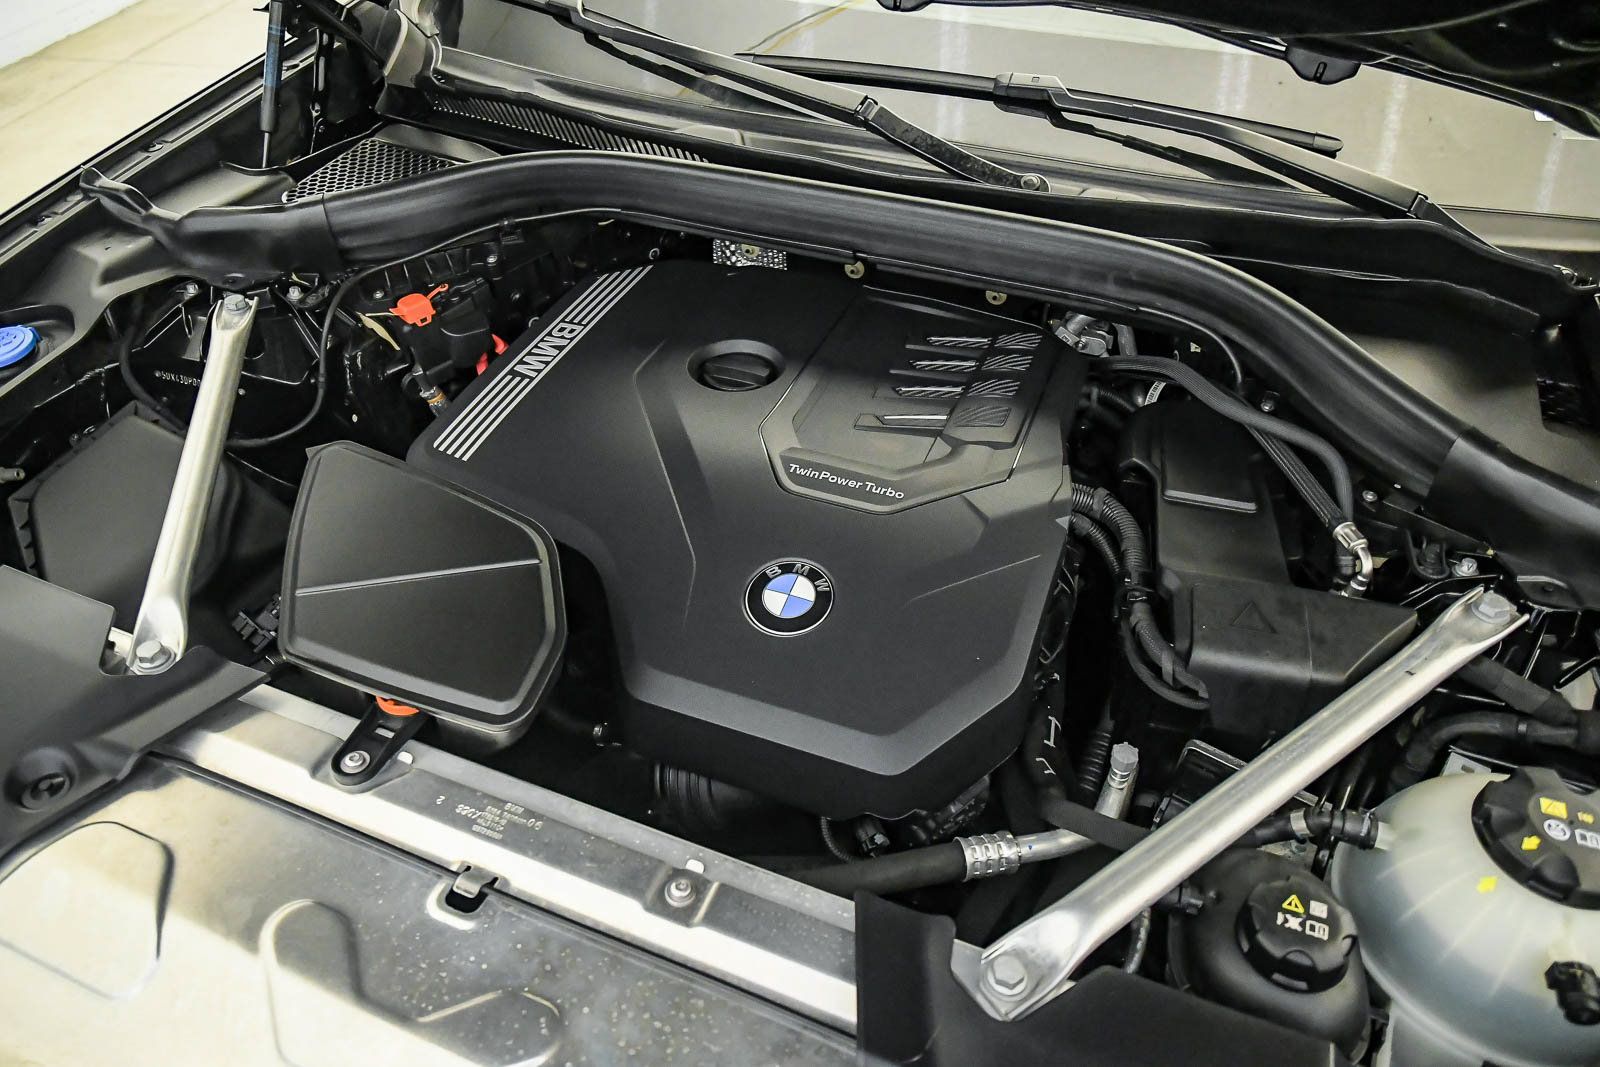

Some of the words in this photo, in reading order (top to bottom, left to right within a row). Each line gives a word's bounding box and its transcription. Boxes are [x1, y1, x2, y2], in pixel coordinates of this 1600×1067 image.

[513, 322, 585, 378] BMW
[788, 463, 863, 489] TwinPower
[864, 481, 905, 499] Turbo
[765, 563, 831, 592] BMW
